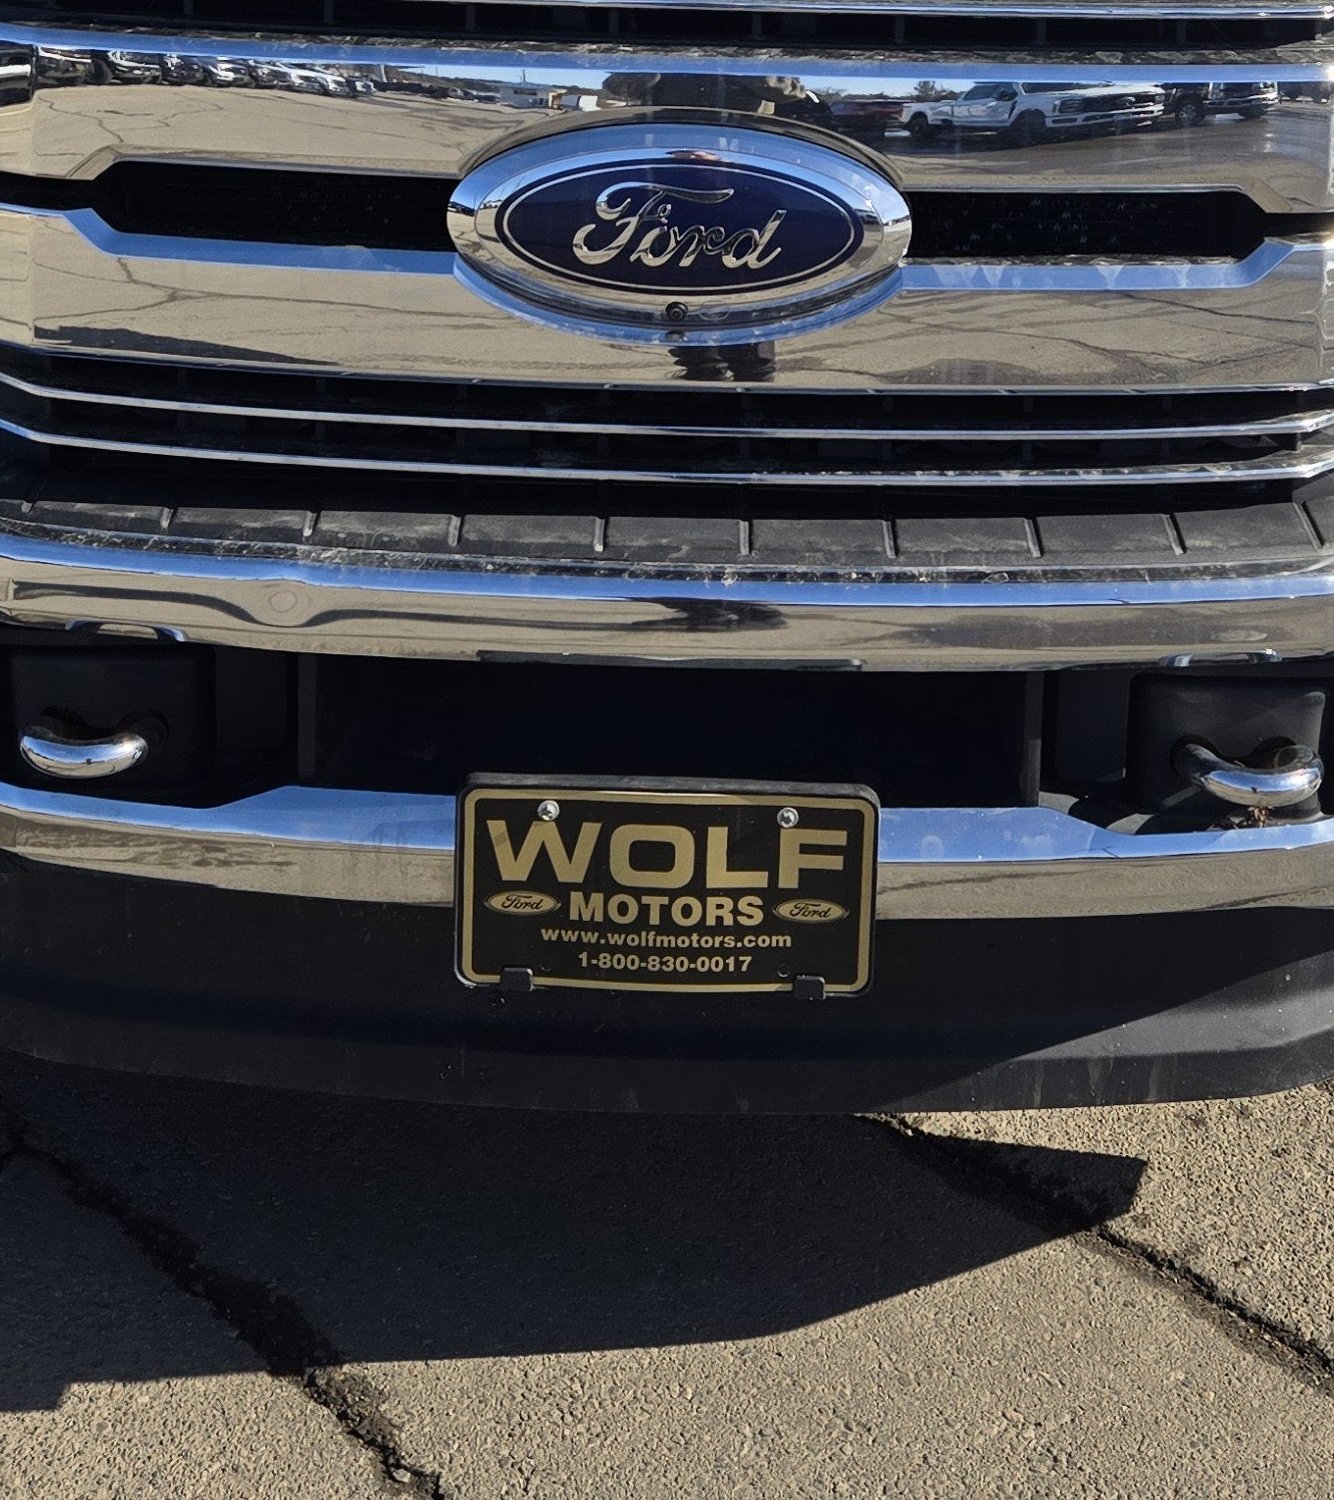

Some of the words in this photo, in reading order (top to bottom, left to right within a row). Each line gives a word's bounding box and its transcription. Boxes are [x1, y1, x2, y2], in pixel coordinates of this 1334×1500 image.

[572, 181, 787, 270] Ford
[485, 819, 848, 890] WOLF
[500, 894, 544, 911] Ford
[568, 892, 764, 927] MOTORS
[788, 903, 832, 919] Ford
[540, 927, 792, 948] www.wolfmotors.com
[578, 951, 753, 973] 1-800-830-0017
